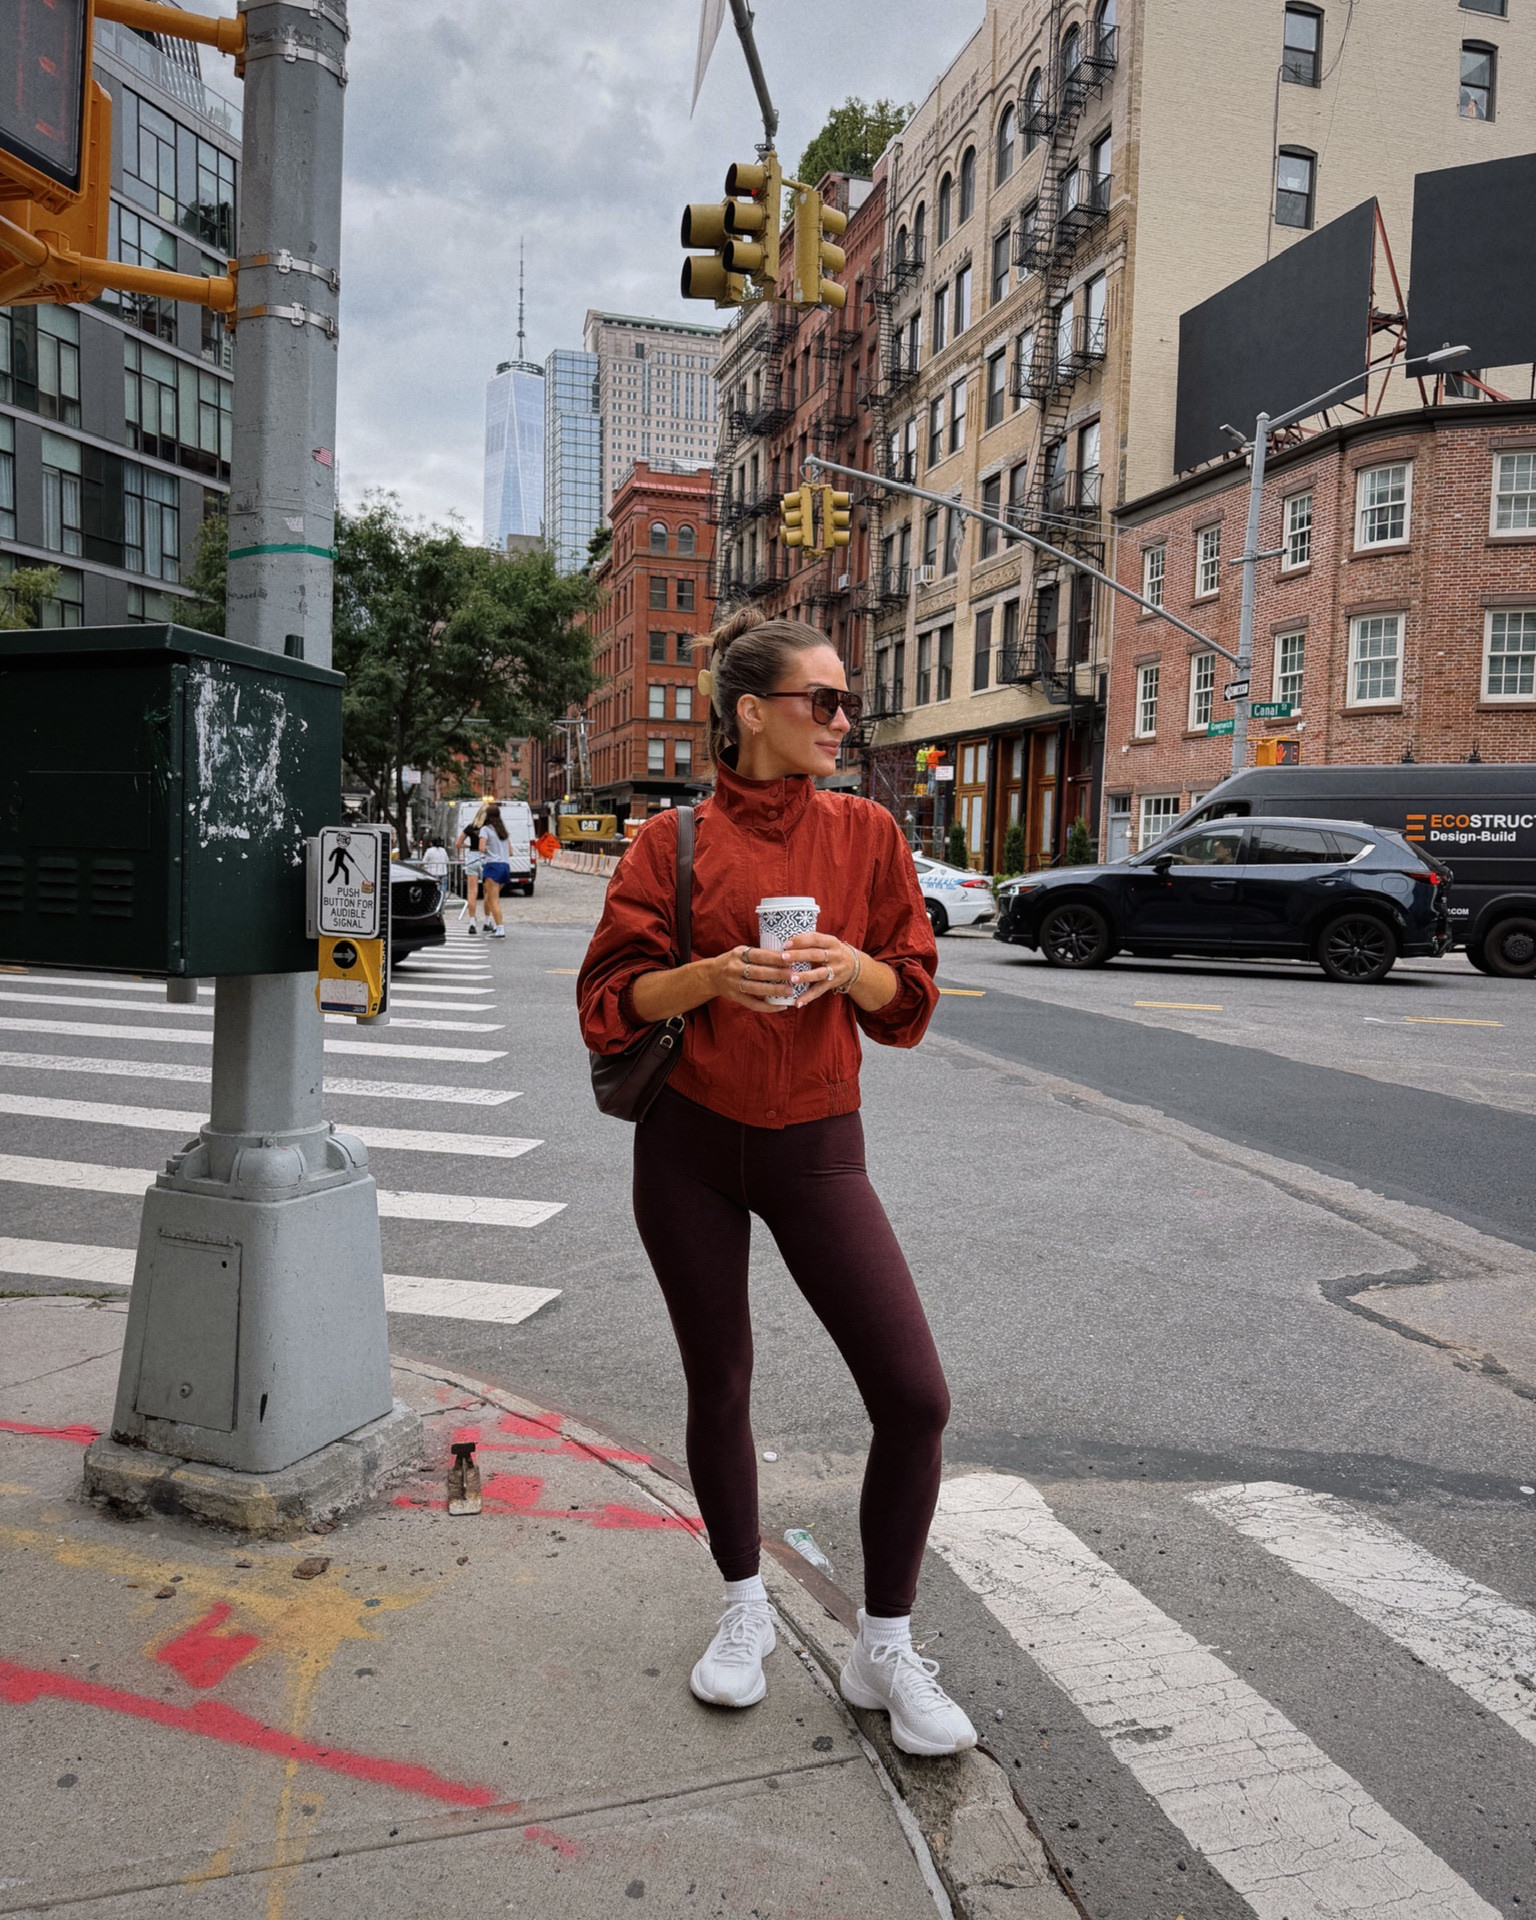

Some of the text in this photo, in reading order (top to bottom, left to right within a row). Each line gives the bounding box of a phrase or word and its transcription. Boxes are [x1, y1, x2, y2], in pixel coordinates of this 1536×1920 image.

[1254, 704, 1278, 716] Canal
[581, 820, 599, 831] CAT
[1430, 814, 1536, 828] ECOSTRUC
[1430, 830, 1516, 844] Design-Build
[337, 887, 360, 898] PUSH
[323, 897, 374, 909] BUTTON FOR
[330, 908, 367, 919] AUDIBLE
[333, 918, 363, 928] SIGNAL
